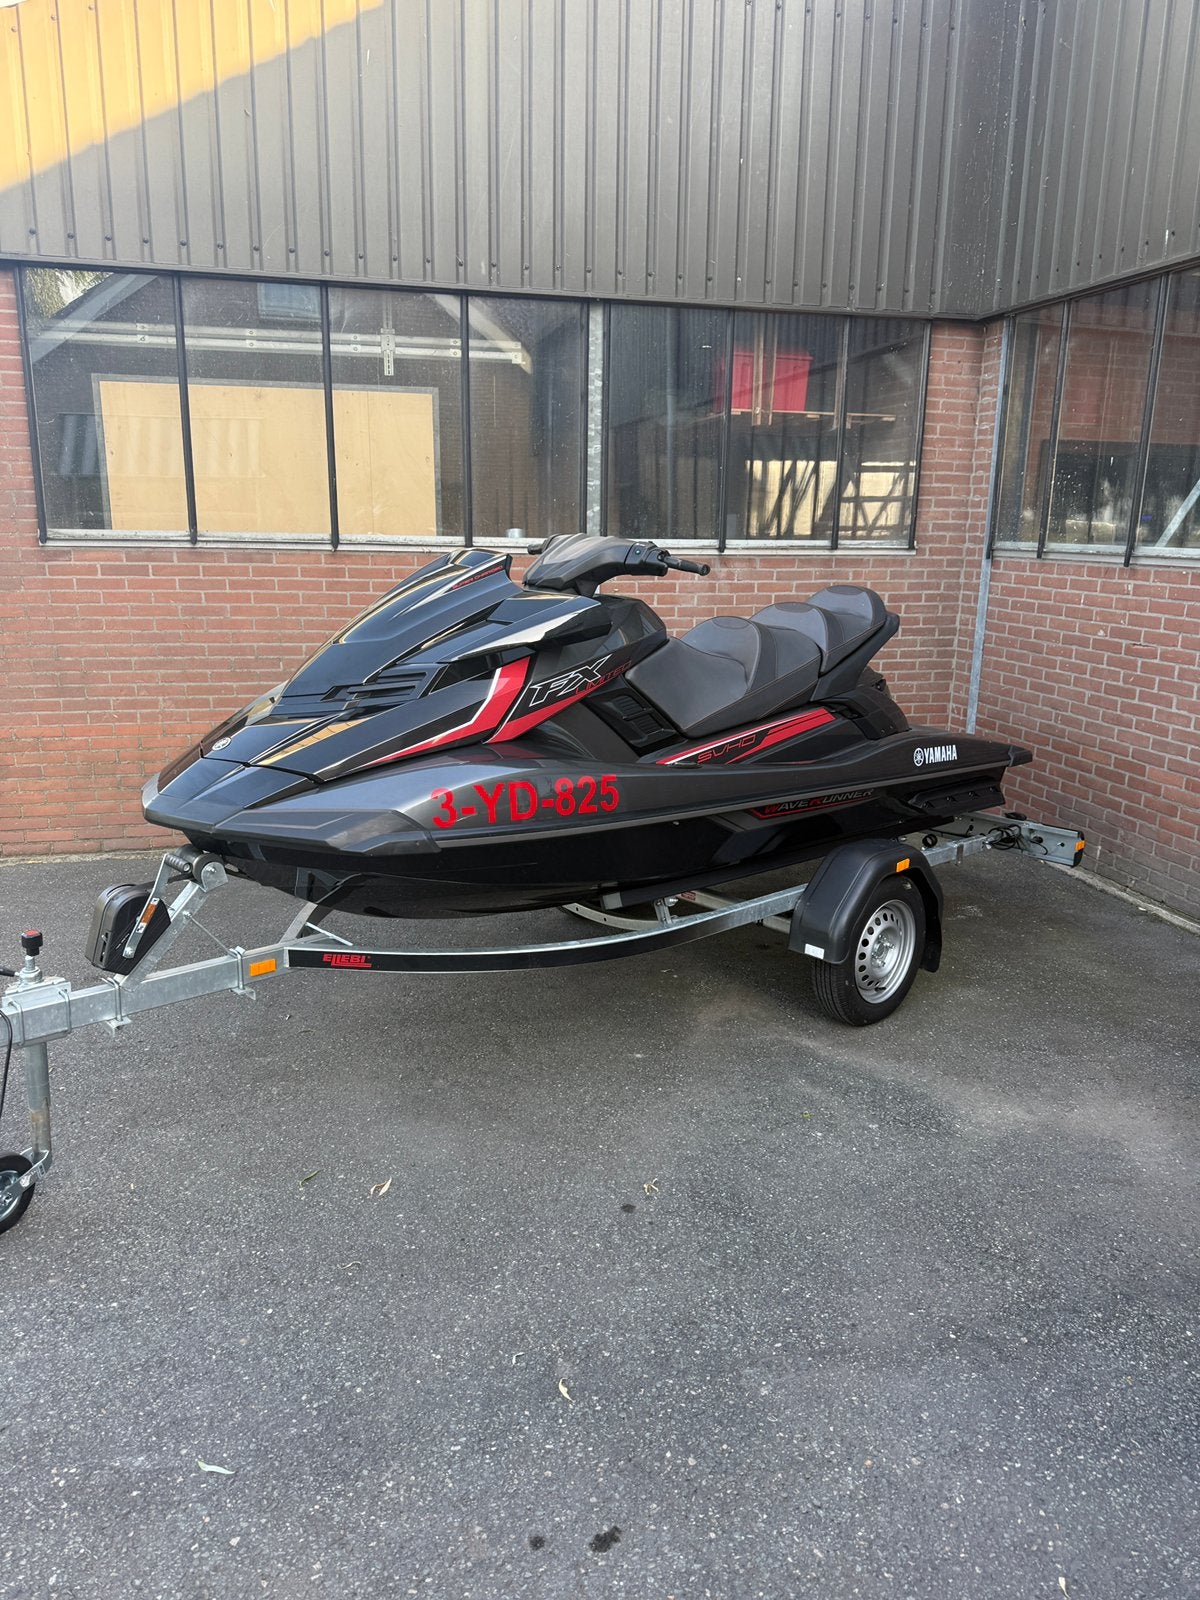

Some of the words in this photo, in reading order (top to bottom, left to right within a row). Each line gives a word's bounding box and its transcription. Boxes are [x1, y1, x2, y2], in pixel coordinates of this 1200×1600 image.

[529, 653, 613, 707] FX
[697, 734, 756, 764] SVHO
[923, 744, 958, 765] YAMAHA
[431, 774, 619, 829] 3-YD-825
[764, 788, 875, 814] WAVERUNNER
